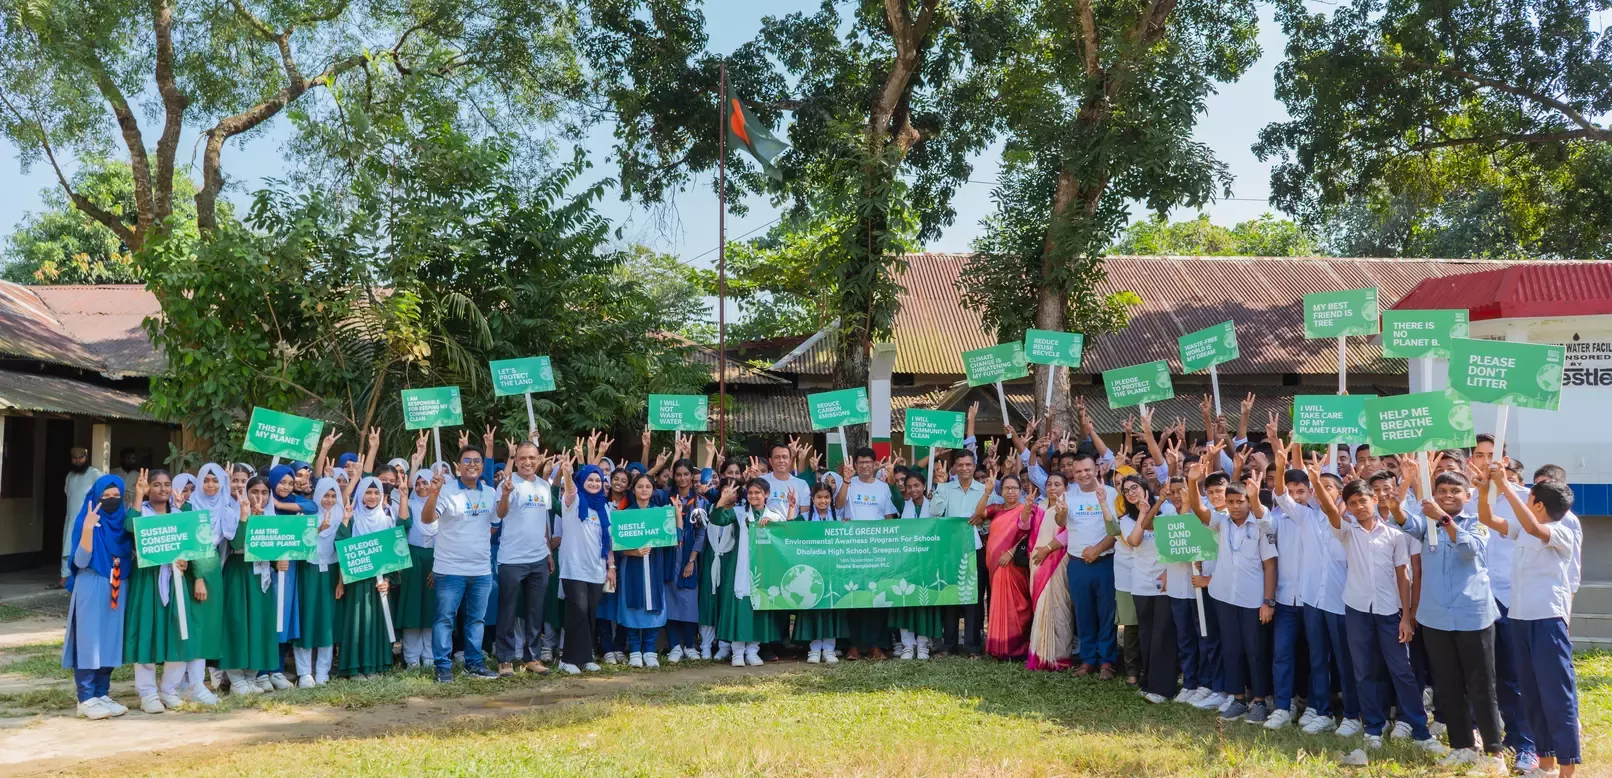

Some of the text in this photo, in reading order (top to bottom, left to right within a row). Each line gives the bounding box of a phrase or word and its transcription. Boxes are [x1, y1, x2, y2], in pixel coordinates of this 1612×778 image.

[1328, 302, 1348, 310] BEST
[1313, 310, 1342, 319] FRIEND
[1184, 336, 1218, 350] WASTE-FREE
[1566, 343, 1590, 352] WATER
[1185, 346, 1205, 356] WORLD
[1197, 349, 1216, 359] DREAM
[969, 354, 994, 363] CLIMATE
[1470, 355, 1516, 367] PLEASE
[970, 360, 994, 368] CHANGE
[971, 362, 1011, 374] THREATENING
[1468, 366, 1507, 378] DON'T
[1115, 377, 1138, 385] PLEDGE
[1122, 381, 1149, 390] PROTECT
[1467, 377, 1507, 389] LITTER
[1127, 386, 1150, 395] PLANET
[819, 410, 850, 419] EMISSIONS
[1379, 407, 1429, 420] HELP ME
[258, 423, 276, 432] THIS
[1380, 417, 1433, 430] BREATHE
[255, 430, 300, 445] MY PLANET
[1382, 428, 1423, 440] FREELY
[618, 521, 645, 530] NESTLÉ
[141, 525, 177, 537] SUSTAIN
[825, 526, 899, 536] NESTLÉ GREEN HAT
[141, 533, 188, 545] CONSERVE
[870, 537, 899, 545] Program
[143, 542, 181, 554] PROTECT
[348, 539, 379, 551] PLEDGE
[358, 545, 383, 557] PLANT
[1171, 546, 1201, 555] FUTURE
[347, 556, 371, 567] MORE
[349, 563, 374, 574] TREES
